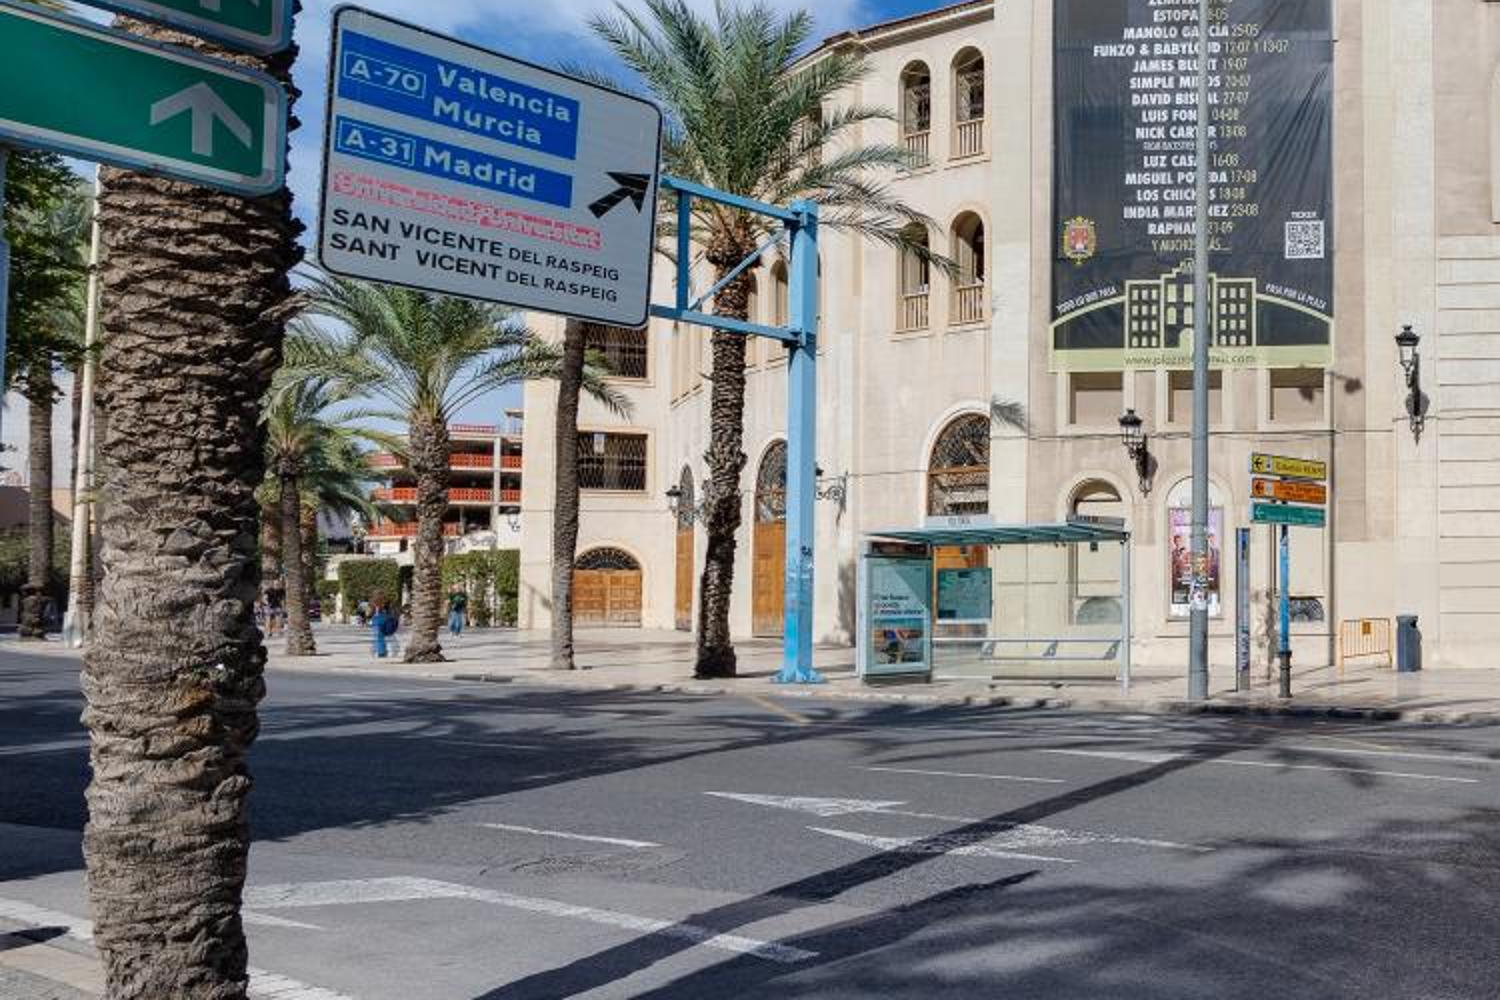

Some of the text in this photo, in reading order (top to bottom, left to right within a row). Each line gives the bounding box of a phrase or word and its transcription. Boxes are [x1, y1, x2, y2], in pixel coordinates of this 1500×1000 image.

[1153, 9, 1199, 23] ESTOPA
[1123, 26, 1178, 41] MANOLO
[1181, 22, 1229, 39] GACÍA
[1139, 43, 1150, 56] &
[1132, 59, 1175, 73] JAMES
[1129, 76, 1175, 89] SIMPLE
[351, 59, 572, 123] A-70 Valencia
[1131, 93, 1171, 106] DAVID
[433, 96, 542, 145] Murcia
[1141, 110, 1168, 123] LUIS
[1135, 126, 1166, 139] NICK
[1169, 125, 1217, 139] CARTR
[346, 126, 536, 194] A-31 Madrid
[1143, 155, 1167, 168] LUZ
[1125, 172, 1174, 185] MIGUEL
[1177, 171, 1228, 184] POEDA
[1137, 189, 1160, 202] LOS
[1163, 188, 1217, 201] CHICHS
[1123, 205, 1160, 219] INDIA
[1163, 204, 1229, 218] MARTEZ
[332, 208, 620, 282] SAN VICENTE DEL RASPEIG
[330, 233, 618, 303] SANT VICENT DEL RASPEIG
